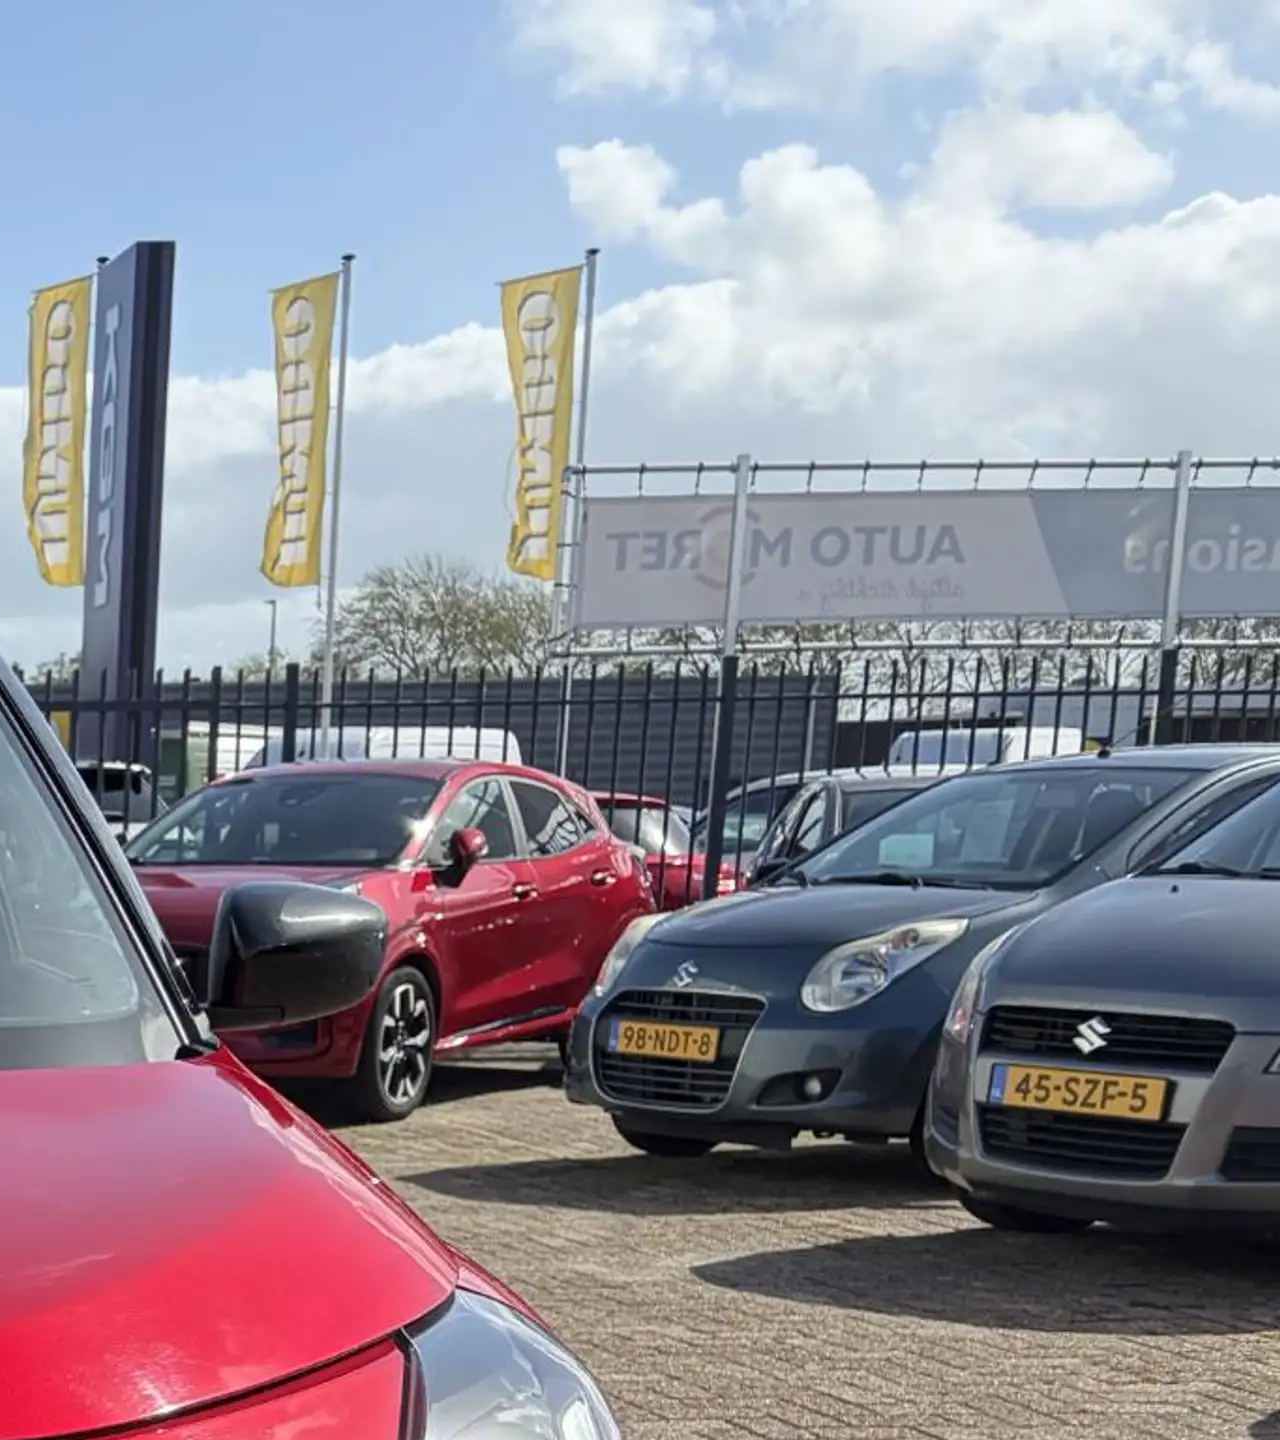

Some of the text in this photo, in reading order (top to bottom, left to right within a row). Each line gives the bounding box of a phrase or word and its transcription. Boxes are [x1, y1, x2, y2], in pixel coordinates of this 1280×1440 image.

[93, 302, 121, 609] KGM
[623, 1025, 712, 1056] 98-NDT-8
[1014, 1073, 1149, 1113] 45-SZF-5
